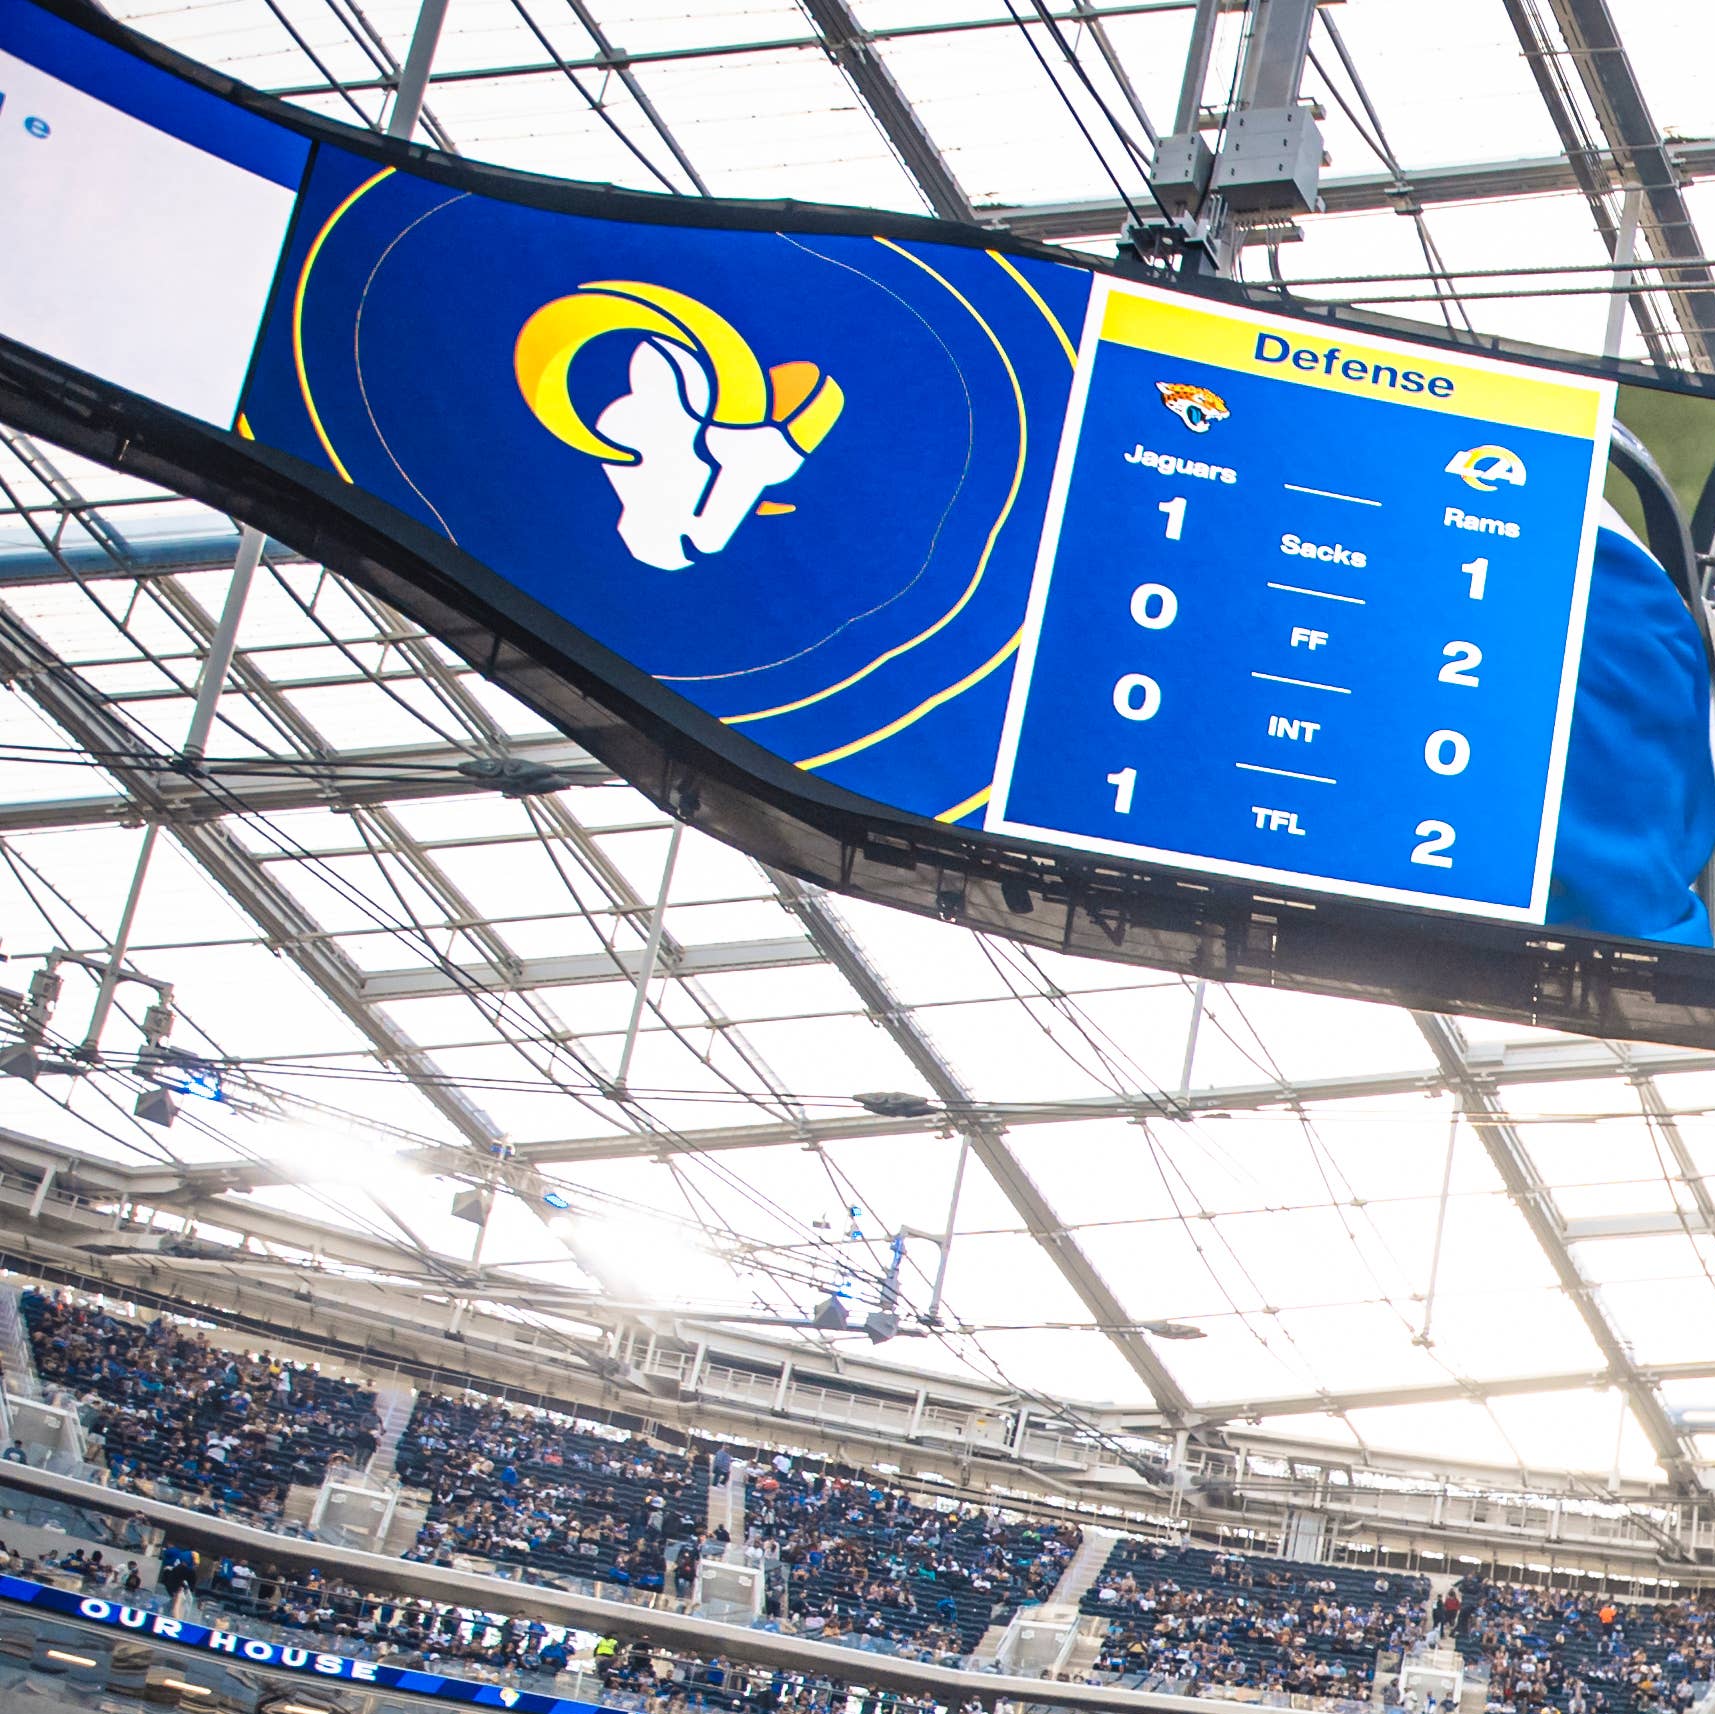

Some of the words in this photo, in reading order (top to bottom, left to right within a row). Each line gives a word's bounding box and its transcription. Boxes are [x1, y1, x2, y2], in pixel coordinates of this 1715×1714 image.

[1254, 332, 1455, 398] Defense
[1124, 444, 1237, 484] Jaguars
[1443, 507, 1520, 538] Rams
[1158, 497, 1187, 540] 1
[1280, 534, 1367, 568] Sacks
[1461, 557, 1489, 600] 1
[1130, 583, 1178, 630] 0
[1290, 627, 1329, 650] FF
[1438, 640, 1483, 688] 2
[1113, 673, 1162, 721] 0
[1268, 716, 1320, 743] INT
[1424, 729, 1471, 776] 0
[1106, 767, 1138, 814] 1
[1252, 806, 1306, 836] TFL
[1411, 819, 1456, 869] 2
[80, 1599, 184, 1638] OUR
[209, 1632, 377, 1681] HOUSE
